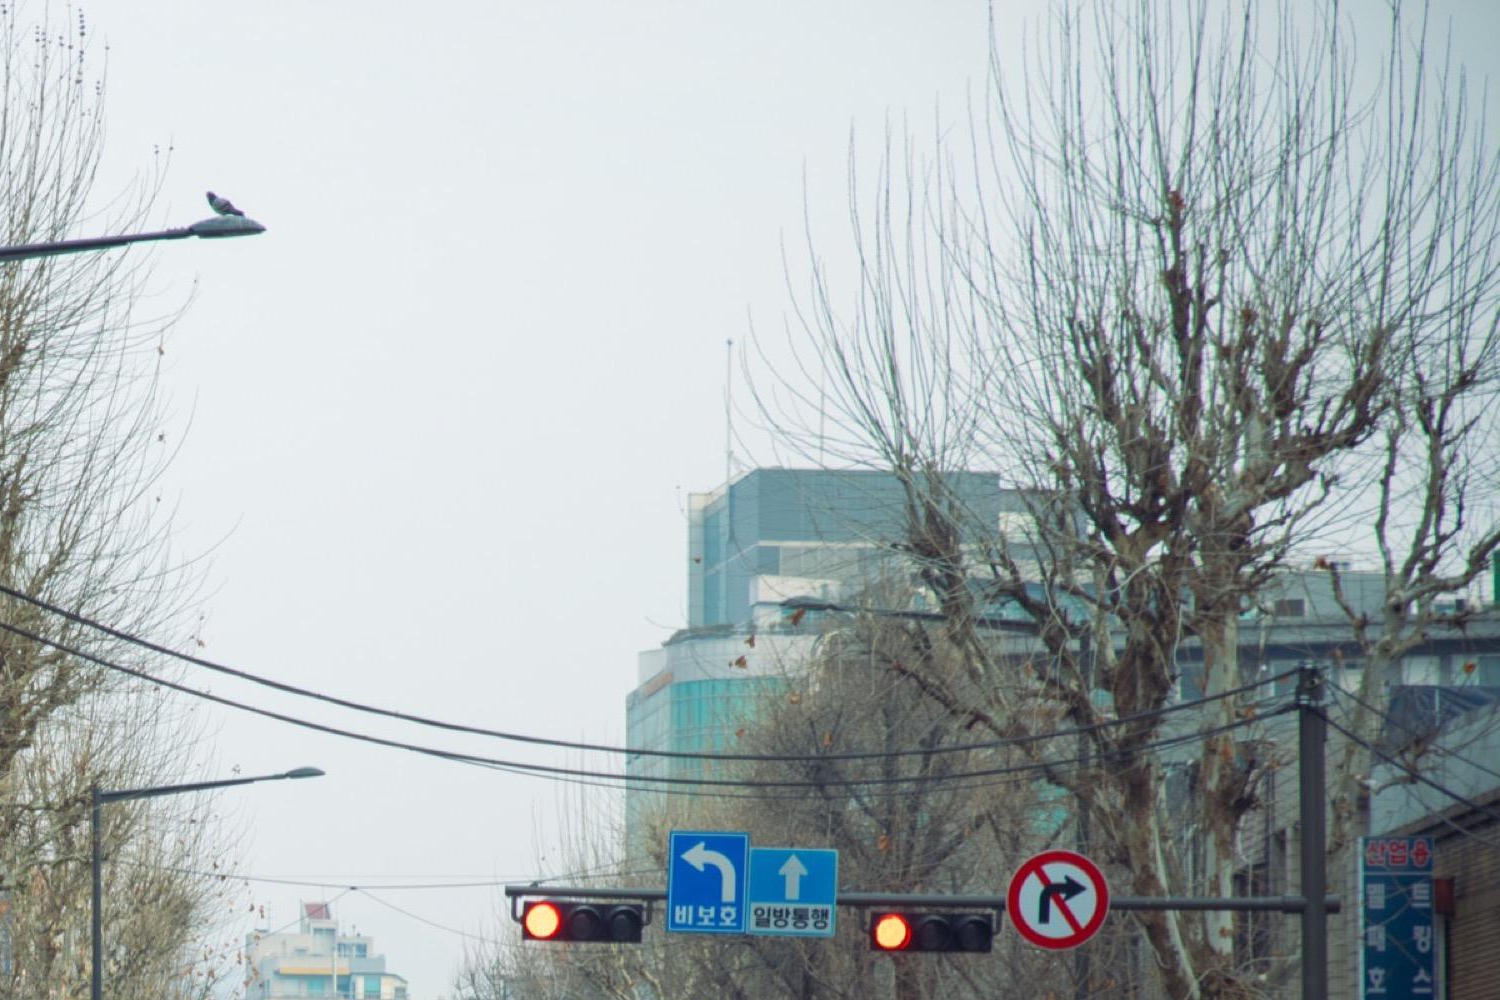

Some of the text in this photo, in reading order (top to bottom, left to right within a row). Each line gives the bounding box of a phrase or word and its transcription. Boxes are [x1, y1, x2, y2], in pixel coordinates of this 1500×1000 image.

[1366, 839, 1431, 868] 산업용
[674, 904, 738, 927] 비보호
[753, 906, 829, 930] 일방통행
